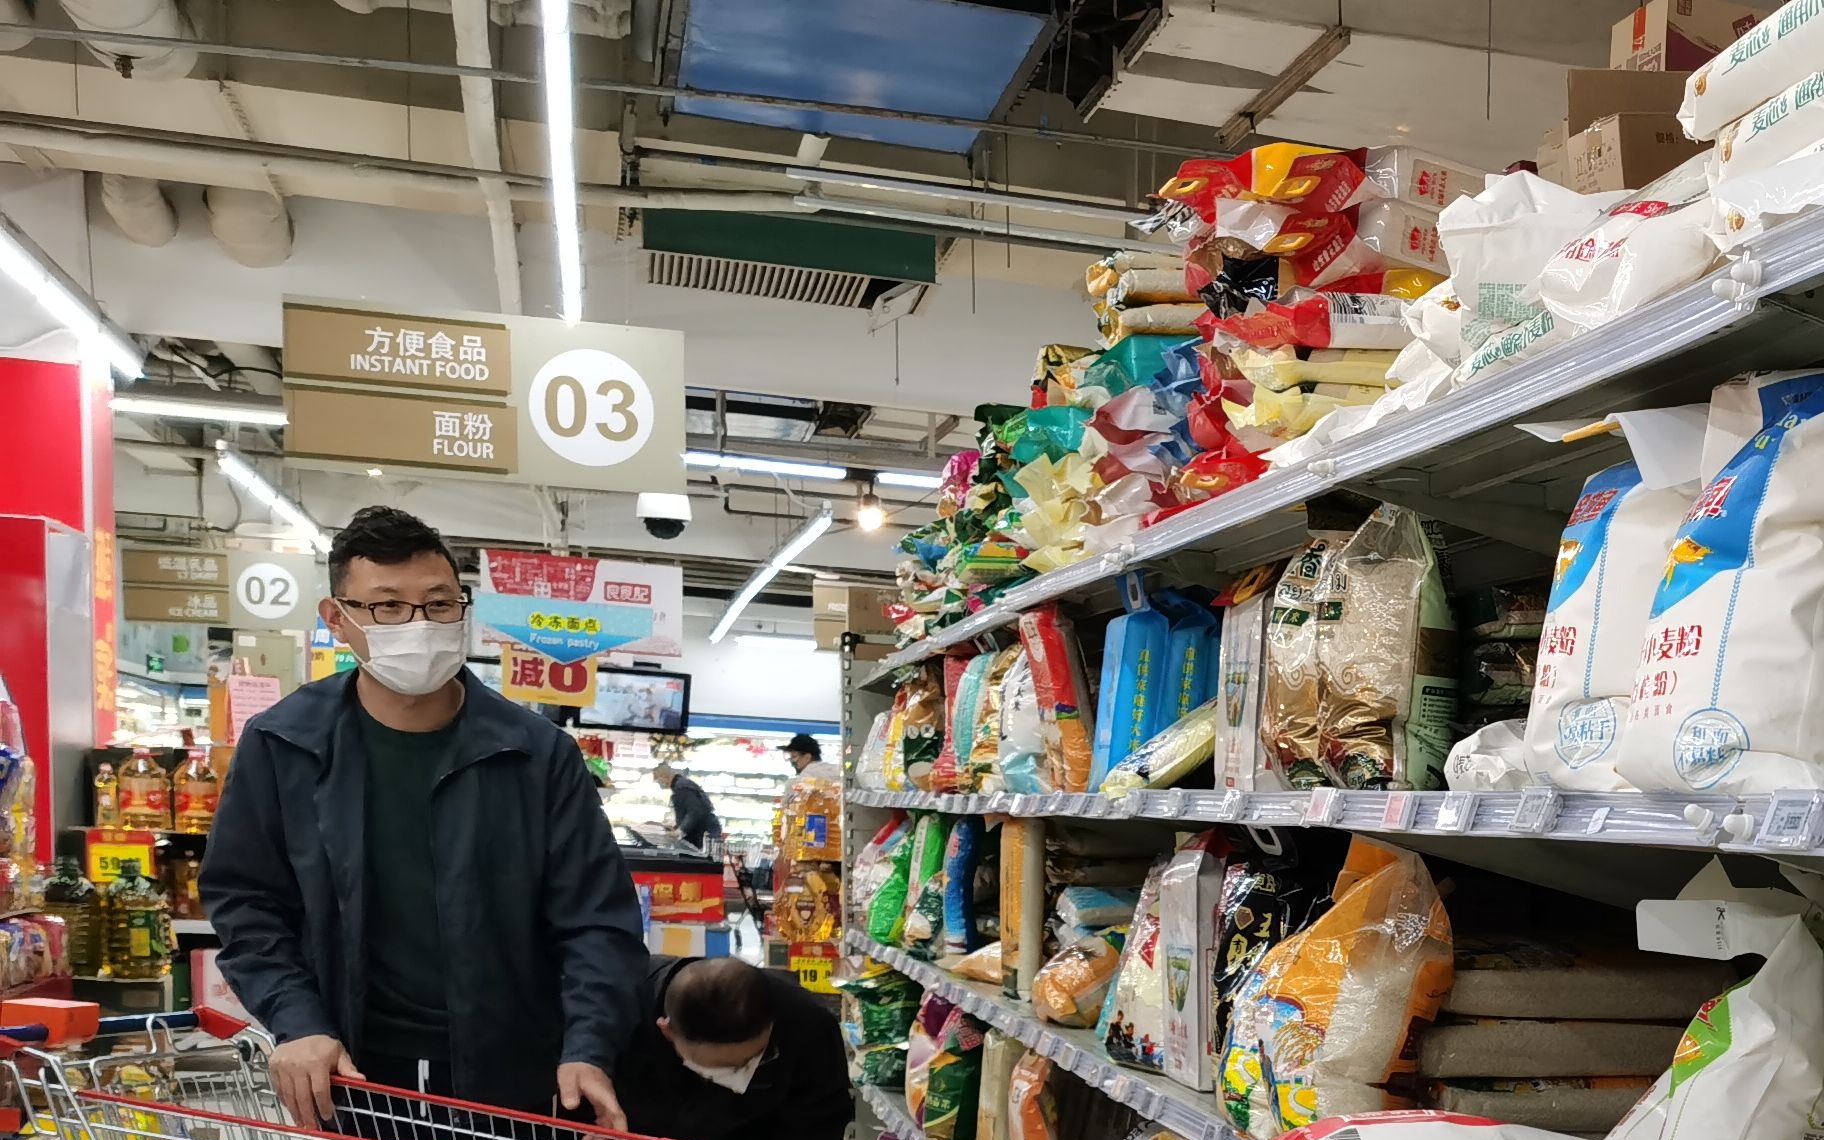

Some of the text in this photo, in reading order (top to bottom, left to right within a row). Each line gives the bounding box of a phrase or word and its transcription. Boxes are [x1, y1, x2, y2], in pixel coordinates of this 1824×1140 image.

[365, 326, 487, 362] 方便食品
[350, 353, 489, 382] INSTANT FOOD
[544, 375, 640, 442] 03
[433, 410, 494, 441] 面粉
[433, 440, 494, 459] FLOUR
[245, 576, 291, 606] 02
[529, 611, 601, 633] 冷冻面点
[529, 632, 600, 650] Frozen pastry
